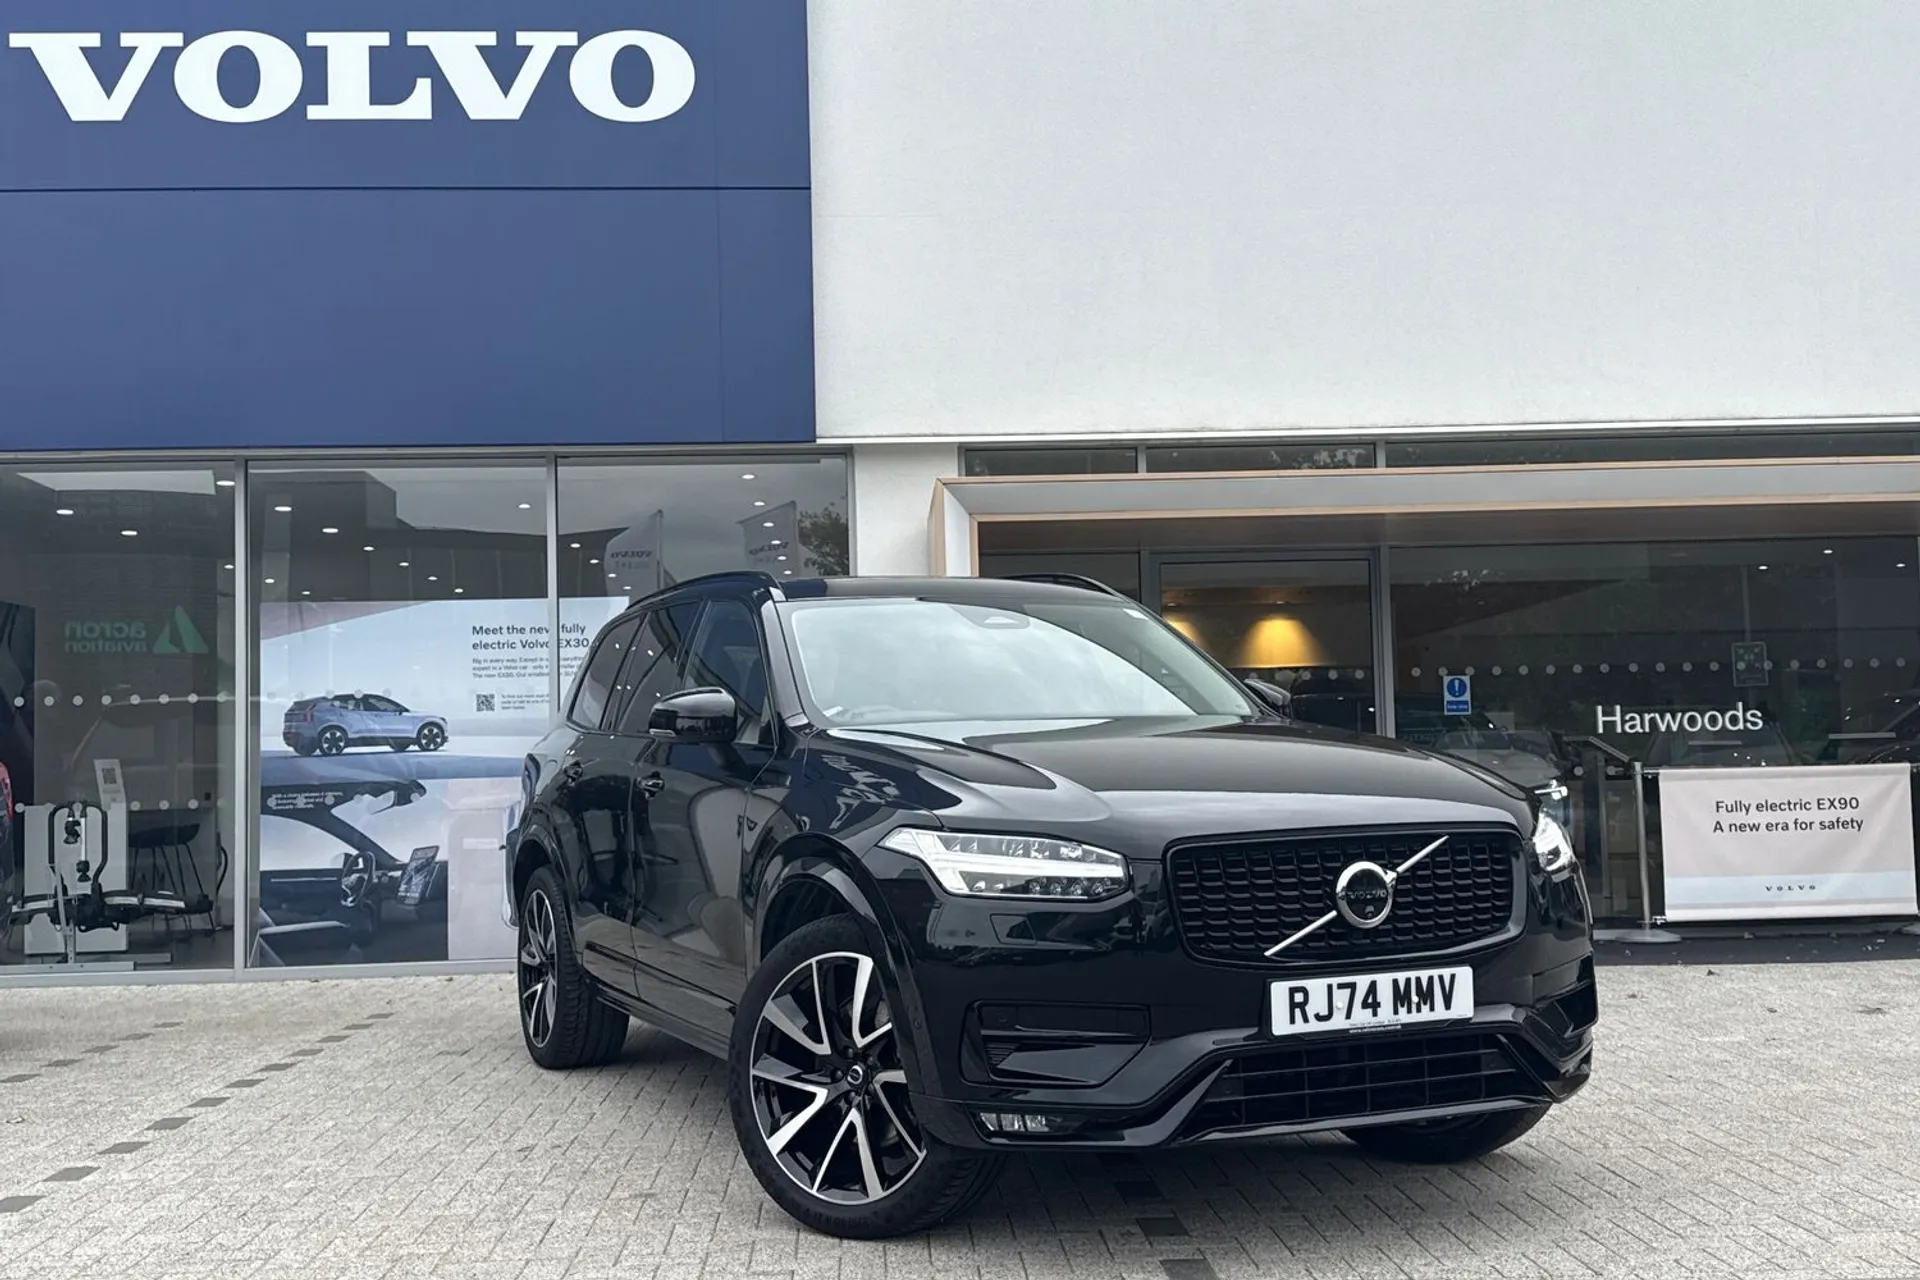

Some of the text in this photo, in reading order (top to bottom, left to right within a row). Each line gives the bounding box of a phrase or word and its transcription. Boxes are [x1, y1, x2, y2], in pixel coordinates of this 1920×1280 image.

[8, 29, 696, 123] VOLVO
[472, 625, 503, 636] Meet
[506, 624, 526, 635] the
[561, 623, 586, 636] fully
[472, 640, 516, 650] electric
[558, 638, 590, 648] EX30
[1596, 701, 1763, 734] Harwoods
[1715, 797, 1860, 815] Fully electric EX90
[1713, 816, 1864, 833] A new era for safety
[1765, 884, 1816, 892] VOLVO
[1288, 973, 1456, 1025] RJ74 MMV
